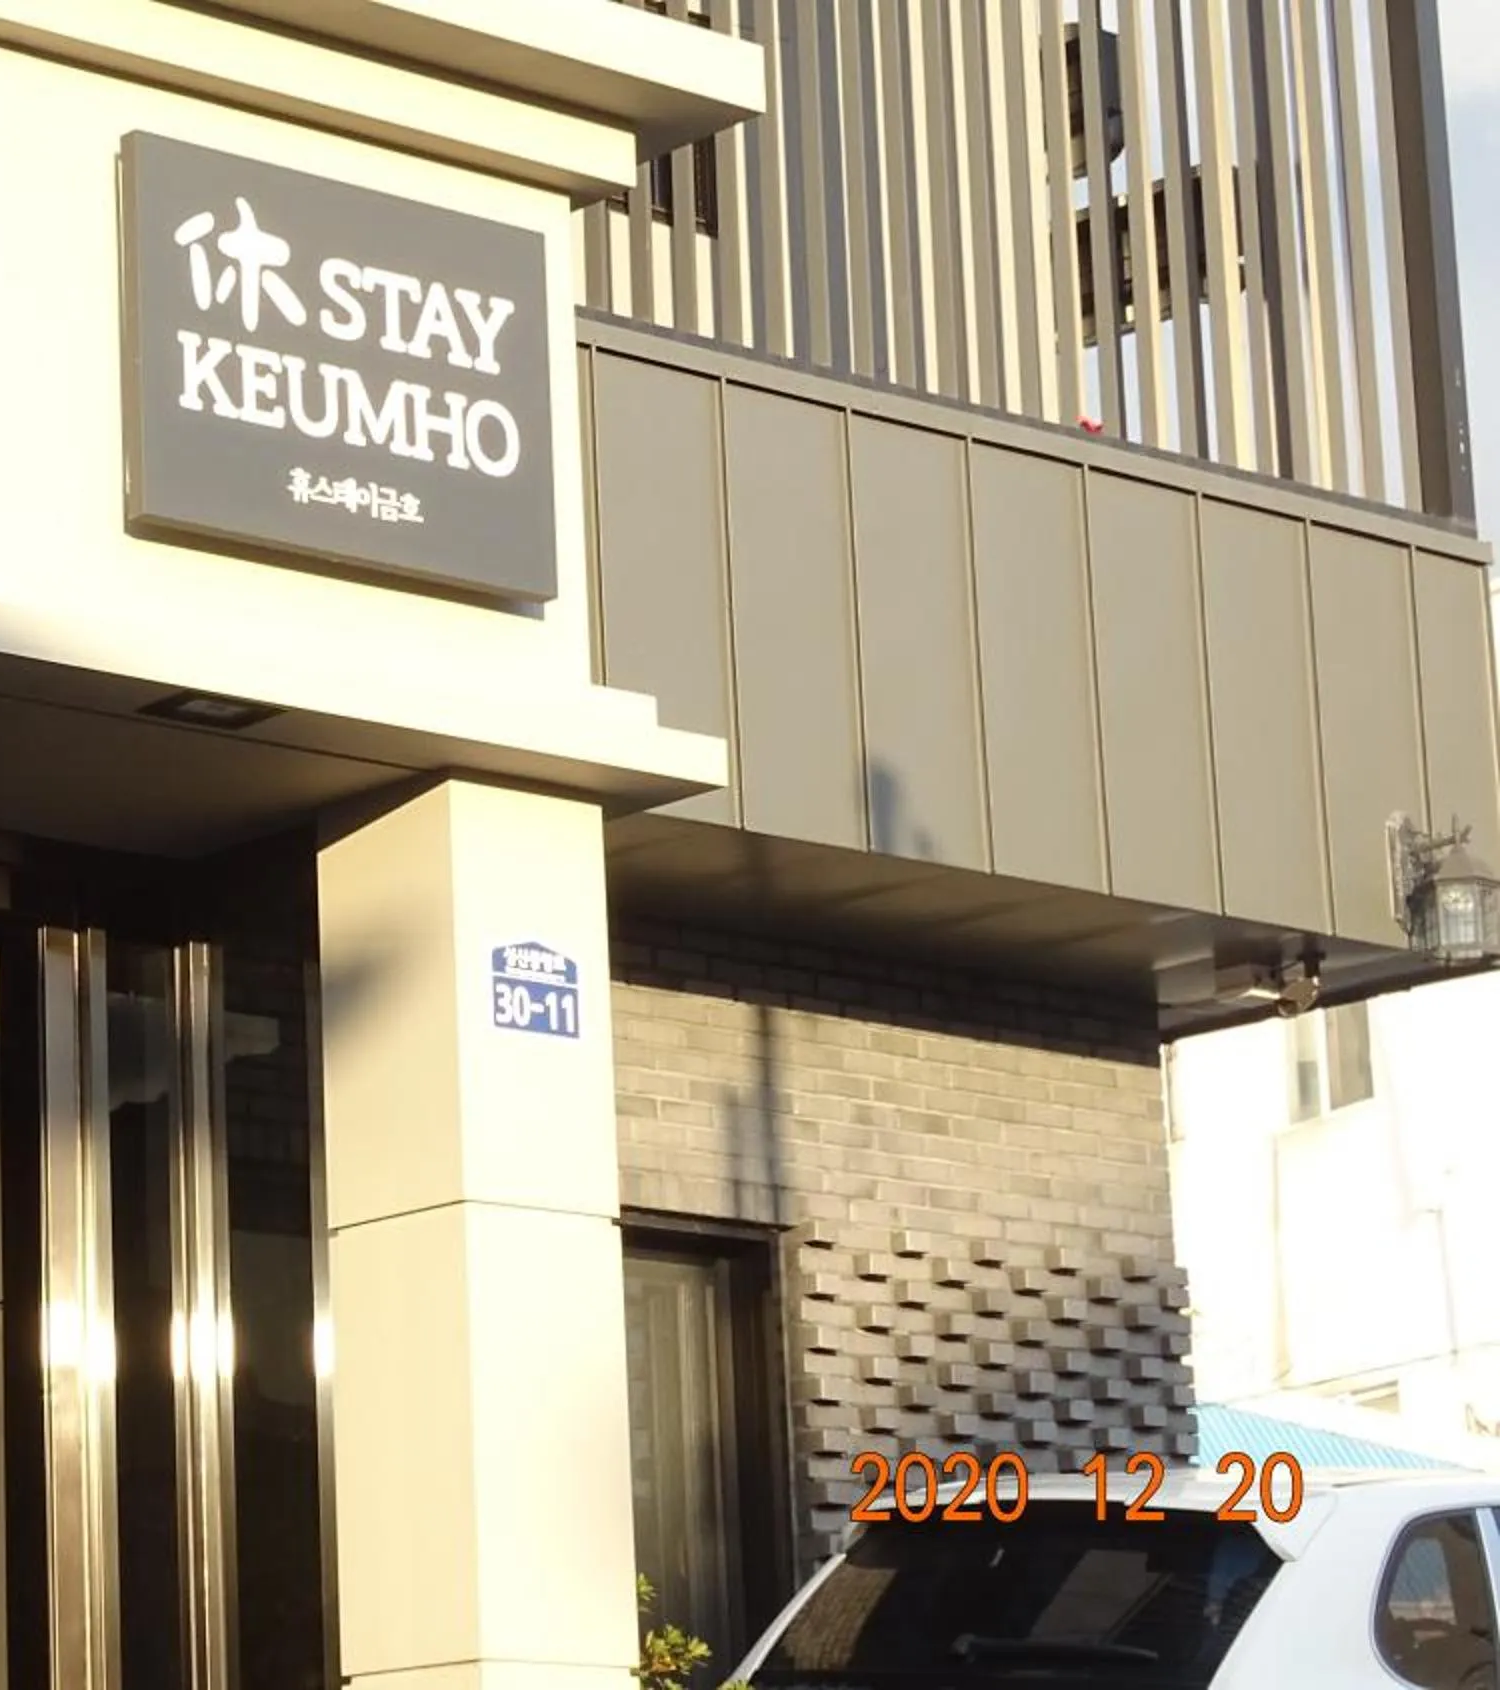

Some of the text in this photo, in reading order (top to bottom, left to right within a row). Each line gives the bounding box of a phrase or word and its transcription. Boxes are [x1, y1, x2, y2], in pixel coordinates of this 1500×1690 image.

[174, 196, 515, 375] 休 STAY
[177, 330, 520, 477] KEUMHO
[287, 467, 424, 524] 휴스테이금호
[495, 983, 575, 1033] 30-11
